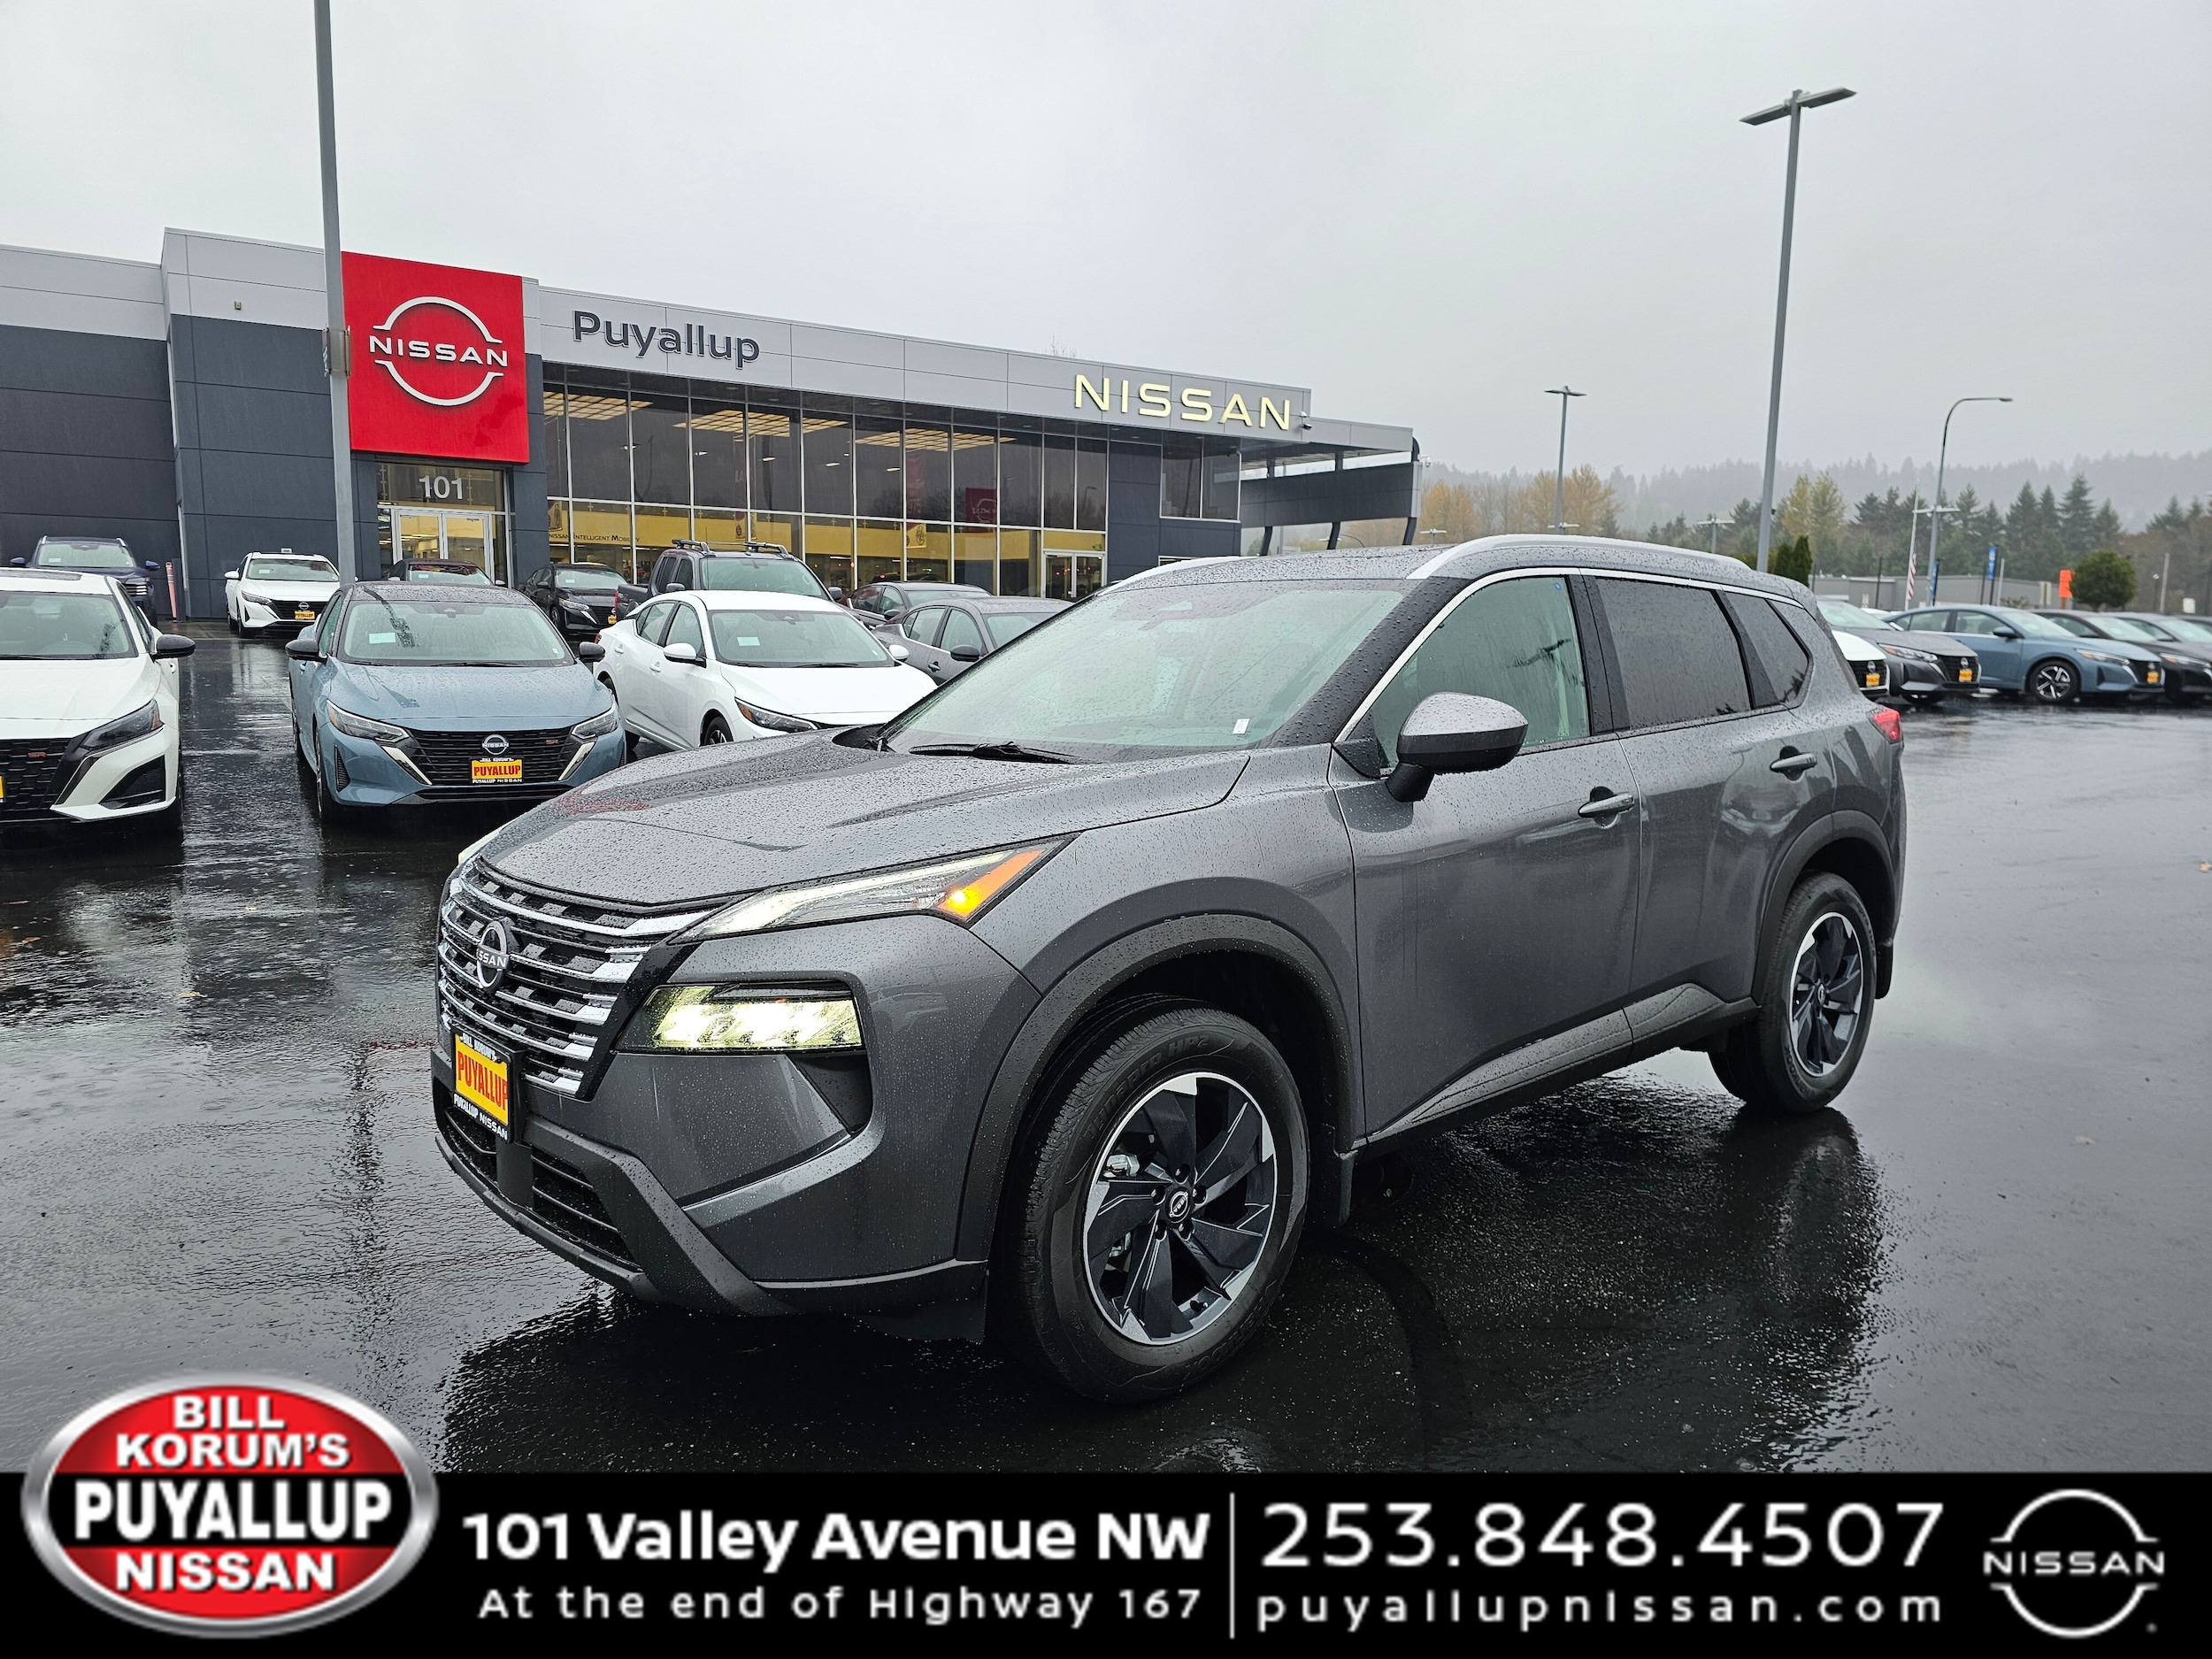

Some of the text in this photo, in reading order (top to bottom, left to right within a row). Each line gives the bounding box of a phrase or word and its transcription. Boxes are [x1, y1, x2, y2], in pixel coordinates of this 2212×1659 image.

[369, 334, 509, 368] NISSAN
[573, 310, 760, 369] Puyallup
[1074, 373, 1292, 431] NISSAN
[419, 475, 465, 501] 101
[473, 765, 520, 776] PUYALLUP
[457, 1050, 509, 1110] PUYALLUP
[479, 1112, 509, 1141] NISSAN
